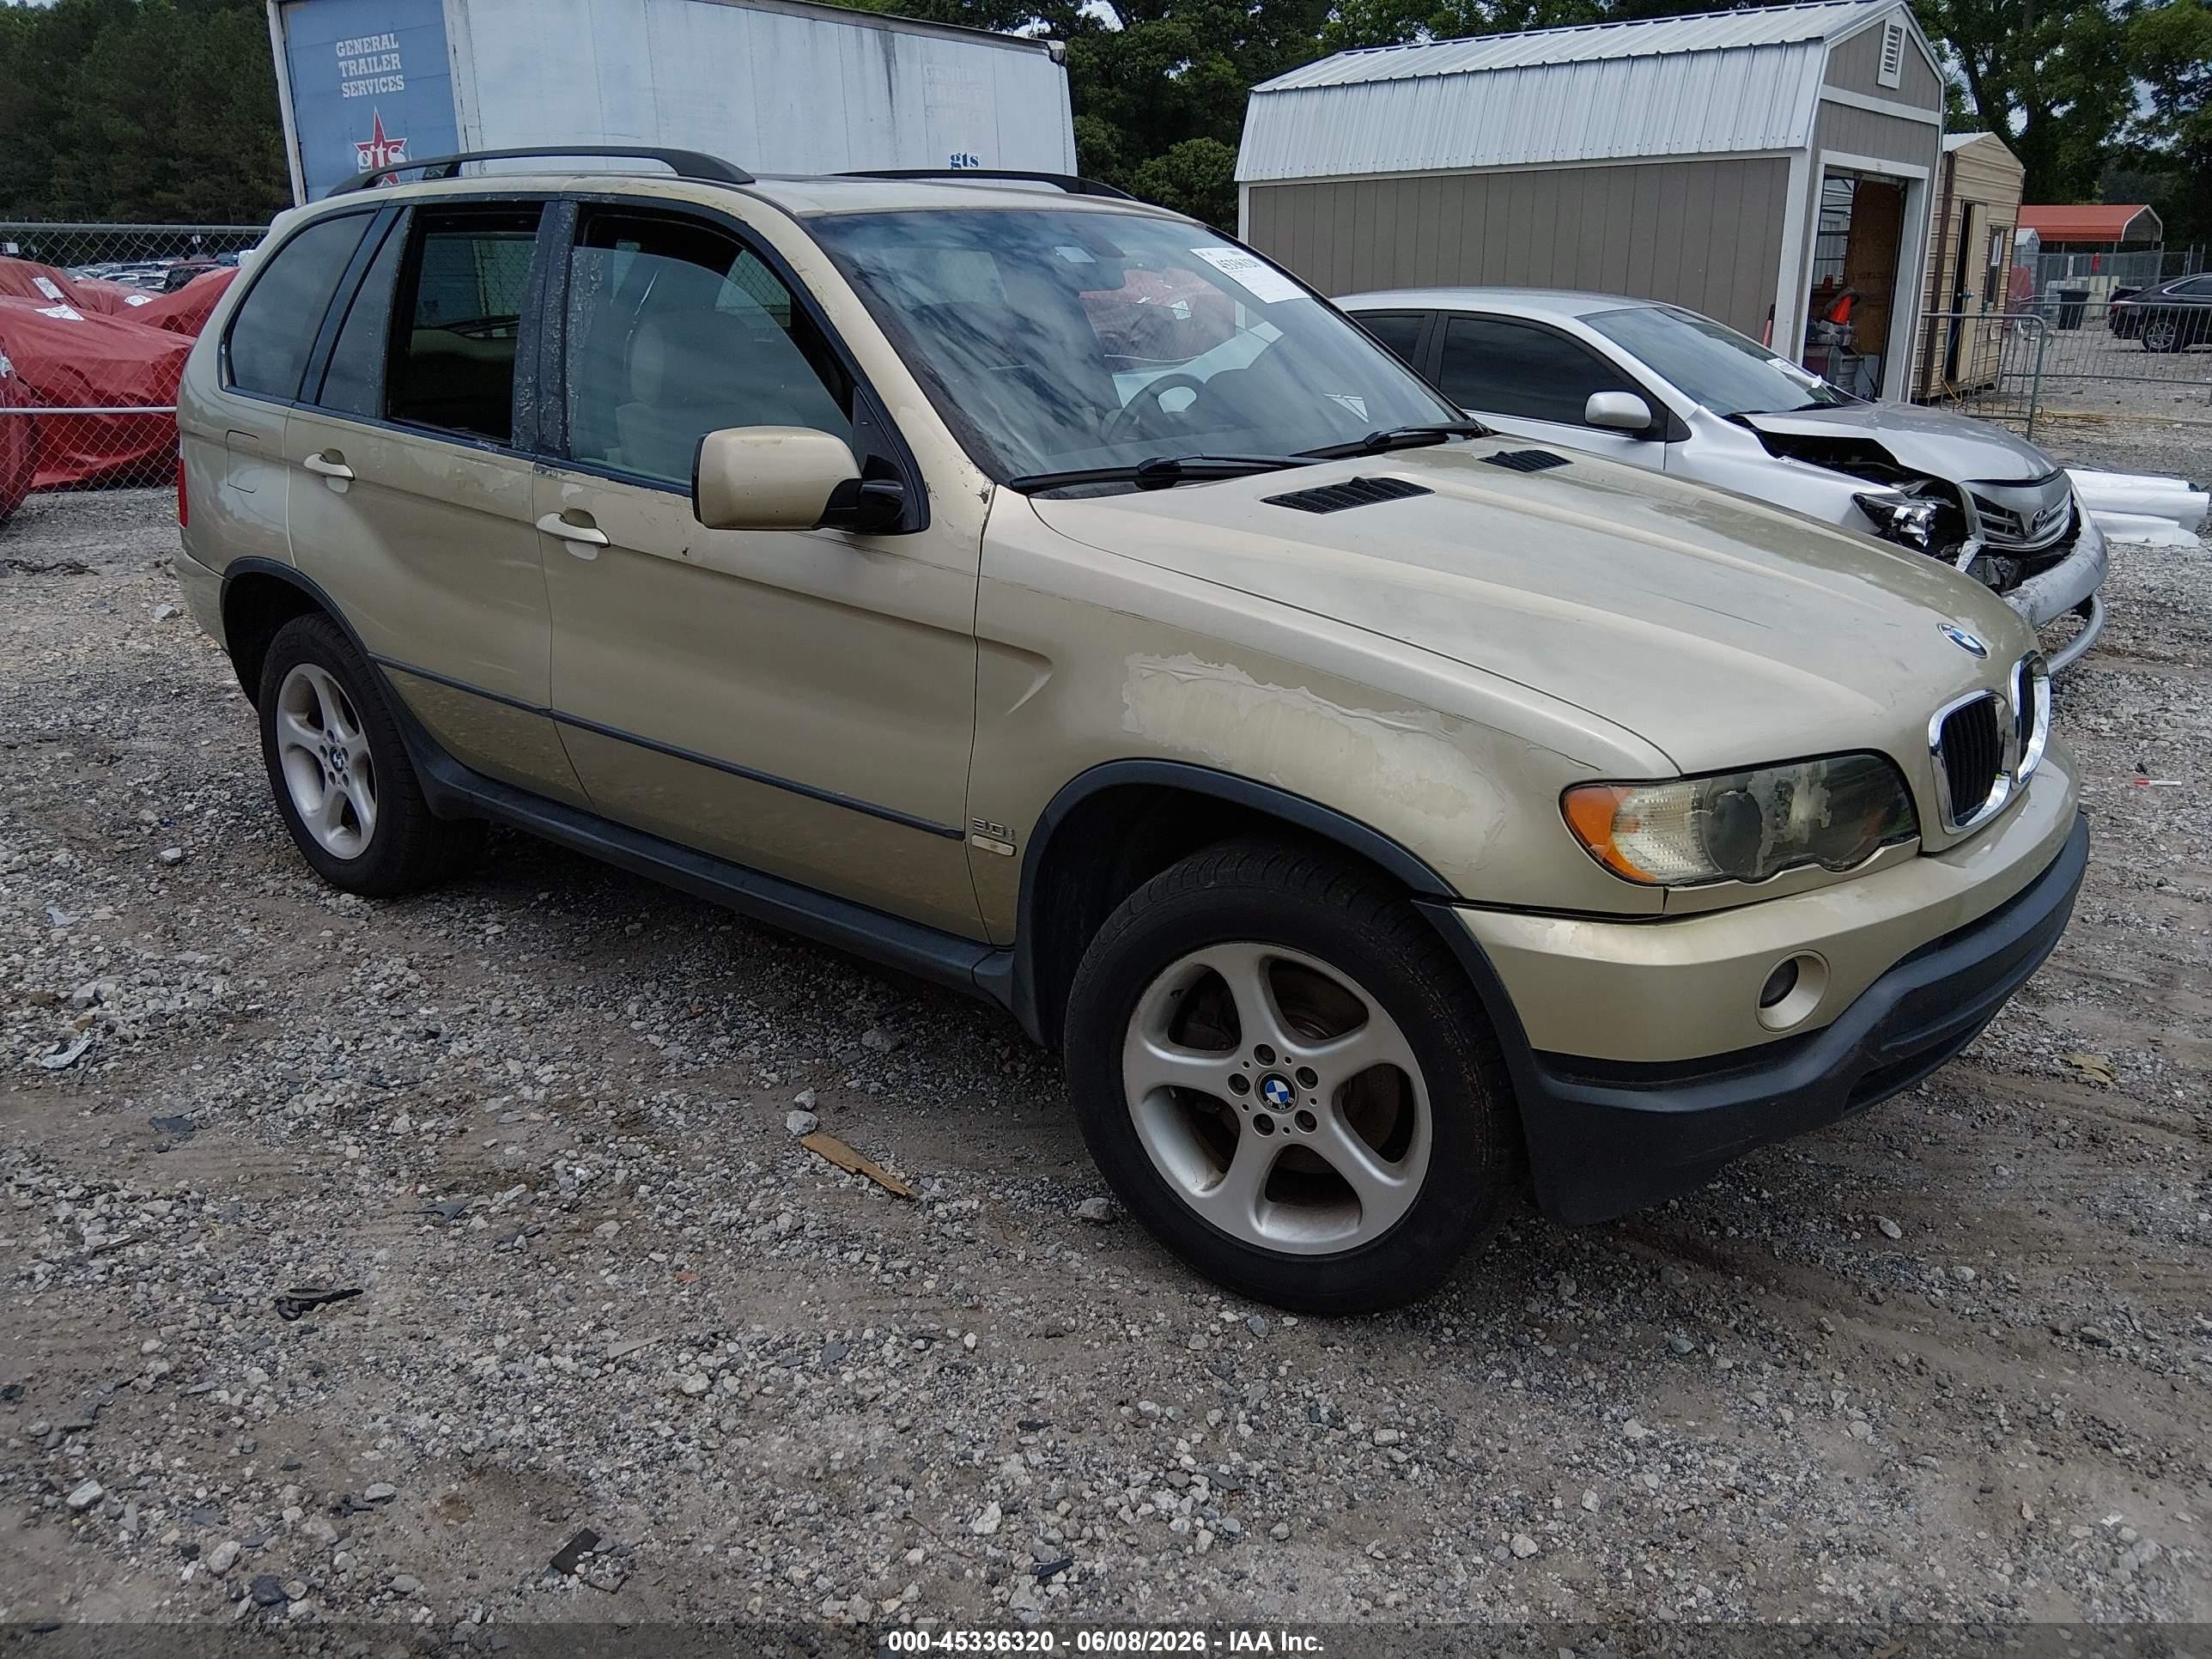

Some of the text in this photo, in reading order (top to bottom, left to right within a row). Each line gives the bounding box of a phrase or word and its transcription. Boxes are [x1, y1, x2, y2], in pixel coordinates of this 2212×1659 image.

[336, 33, 399, 58] GENERAL
[337, 53, 402, 78] TRAILER
[341, 75, 404, 98] SERVICES
[950, 151, 979, 170] gts
